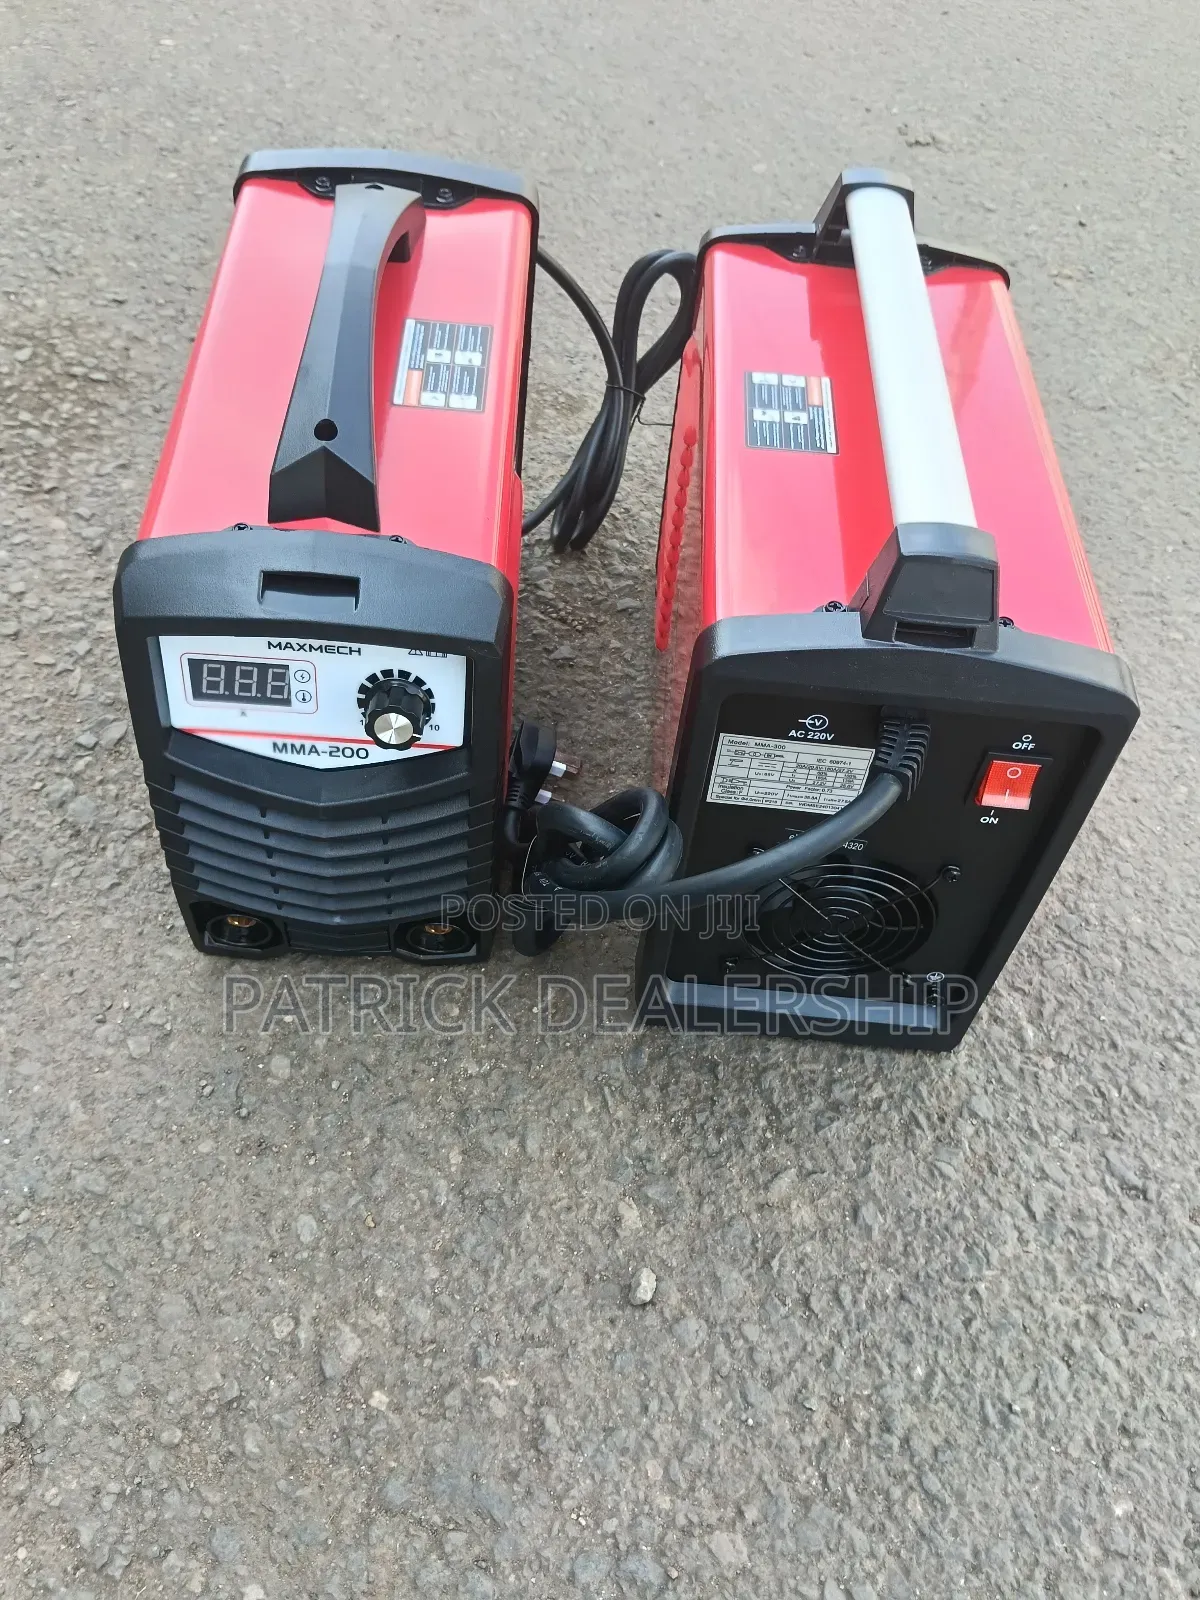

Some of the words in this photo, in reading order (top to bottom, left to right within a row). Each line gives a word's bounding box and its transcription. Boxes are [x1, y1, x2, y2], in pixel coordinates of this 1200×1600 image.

[267, 640, 362, 656] MAXMECH
[428, 724, 440, 732] 10
[788, 729, 805, 738] AC
[807, 731, 835, 741] 220V
[728, 739, 750, 747] Model:
[754, 741, 786, 750] MMA-300
[1012, 741, 1036, 751] OFF
[272, 741, 369, 760] MMA-200
[979, 816, 999, 825] ON
